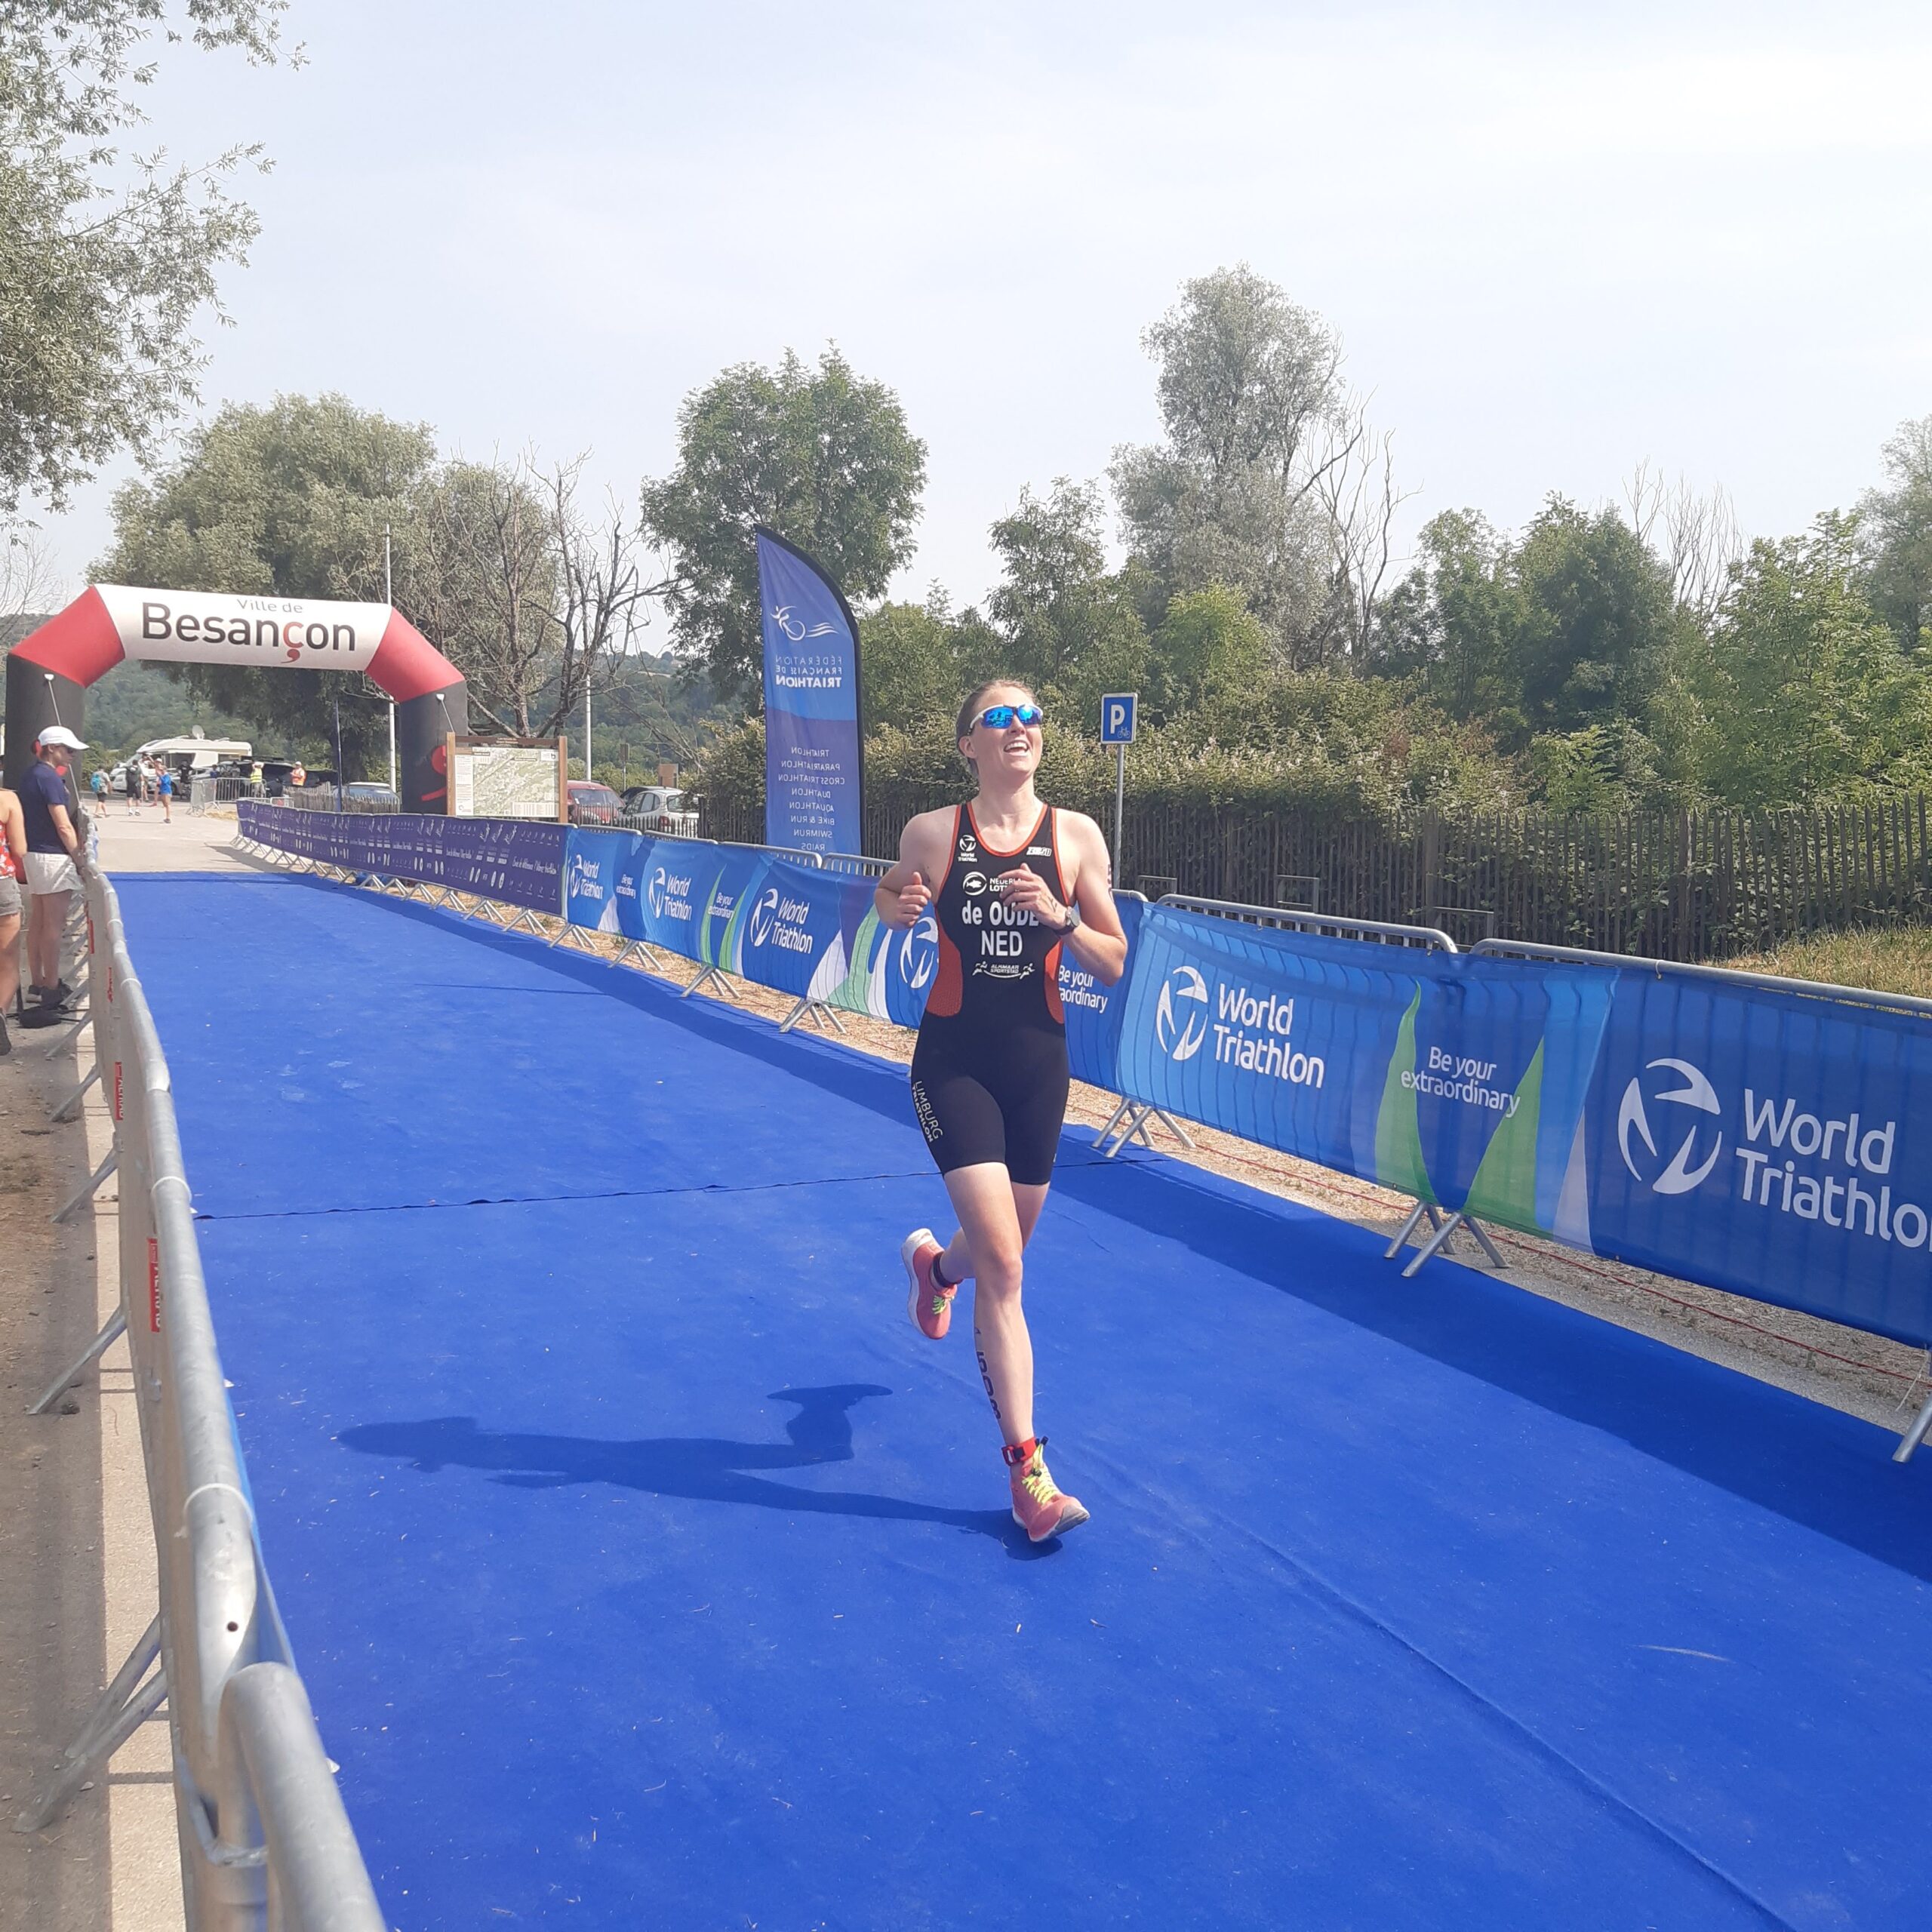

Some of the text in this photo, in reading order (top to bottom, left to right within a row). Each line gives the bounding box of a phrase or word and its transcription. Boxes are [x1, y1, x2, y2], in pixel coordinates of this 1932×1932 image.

[237, 598, 303, 614] Ville de
[142, 601, 355, 664] Besançon
[1110, 704, 1125, 734] P
[666, 874, 692, 897] World
[664, 896, 693, 921] Triathlon
[777, 897, 810, 924] World
[961, 900, 983, 925] de
[771, 921, 814, 955] Triathlon
[981, 930, 1023, 956] NED
[1058, 964, 1071, 983] Be
[1217, 983, 1295, 1036] World
[1213, 1023, 1325, 1090] Triathlon
[1429, 1046, 1497, 1081] Be your
[915, 1080, 943, 1140] LIMBURG
[1401, 1069, 1521, 1118] extraordinary
[1743, 1088, 1896, 1174] World
[1736, 1147, 1932, 1253] Triathlo
